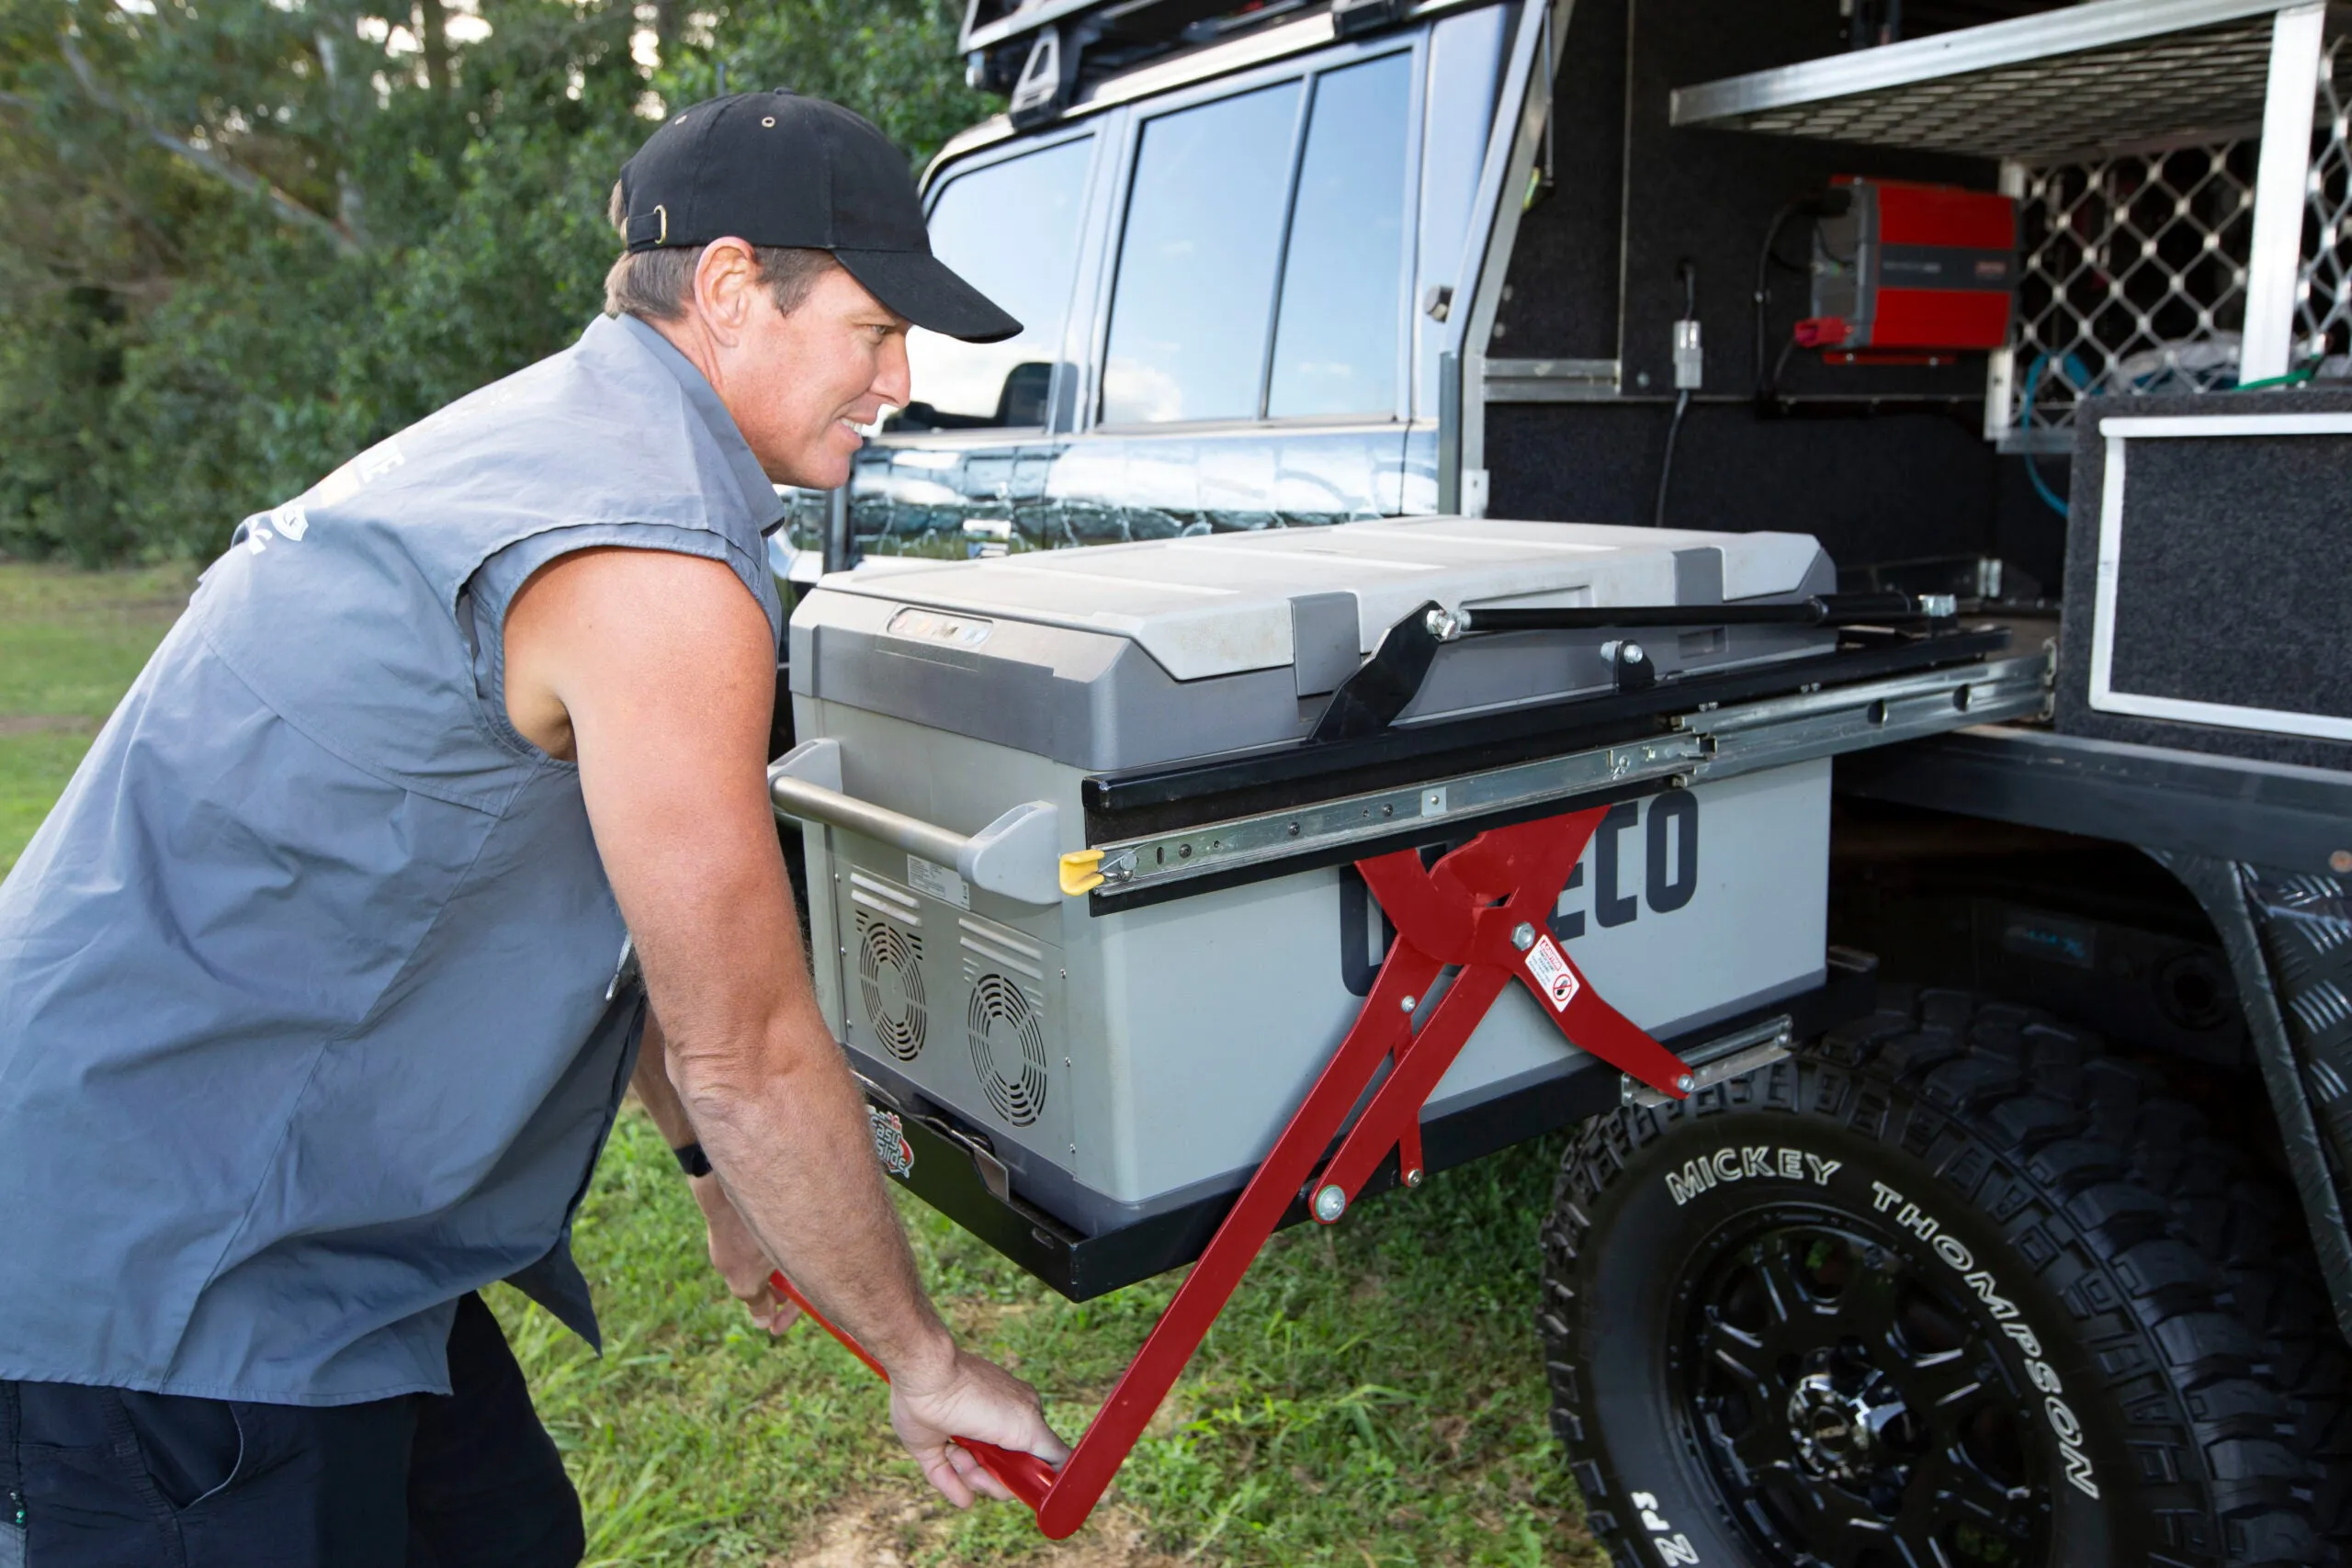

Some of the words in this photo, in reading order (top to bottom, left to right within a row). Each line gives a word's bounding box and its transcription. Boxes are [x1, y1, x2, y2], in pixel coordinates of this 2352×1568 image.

[876, 1139, 907, 1171] Slide
[1665, 1145, 1842, 1205] MICKEY
[1871, 1181, 2099, 1499] THOMPSON
